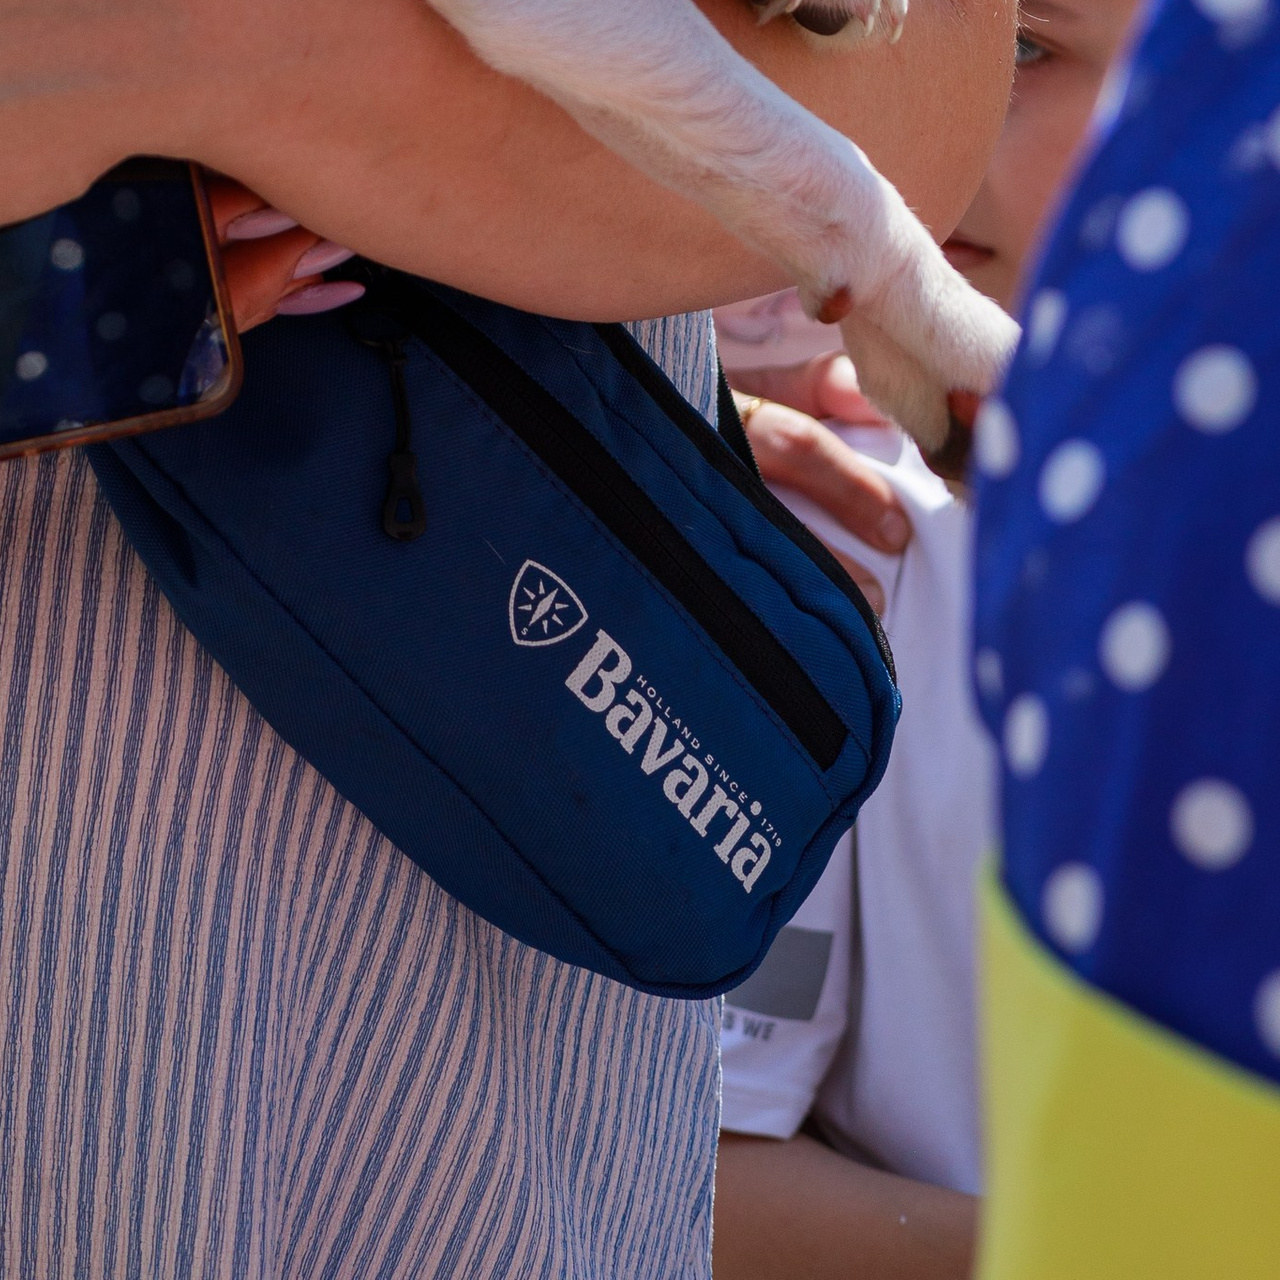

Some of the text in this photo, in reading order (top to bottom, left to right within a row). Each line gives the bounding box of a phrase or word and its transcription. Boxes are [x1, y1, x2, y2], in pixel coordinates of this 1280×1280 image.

[565, 629, 771, 893] Bavaria
[637, 675, 782, 847] HOLLAND SINCE 1719
